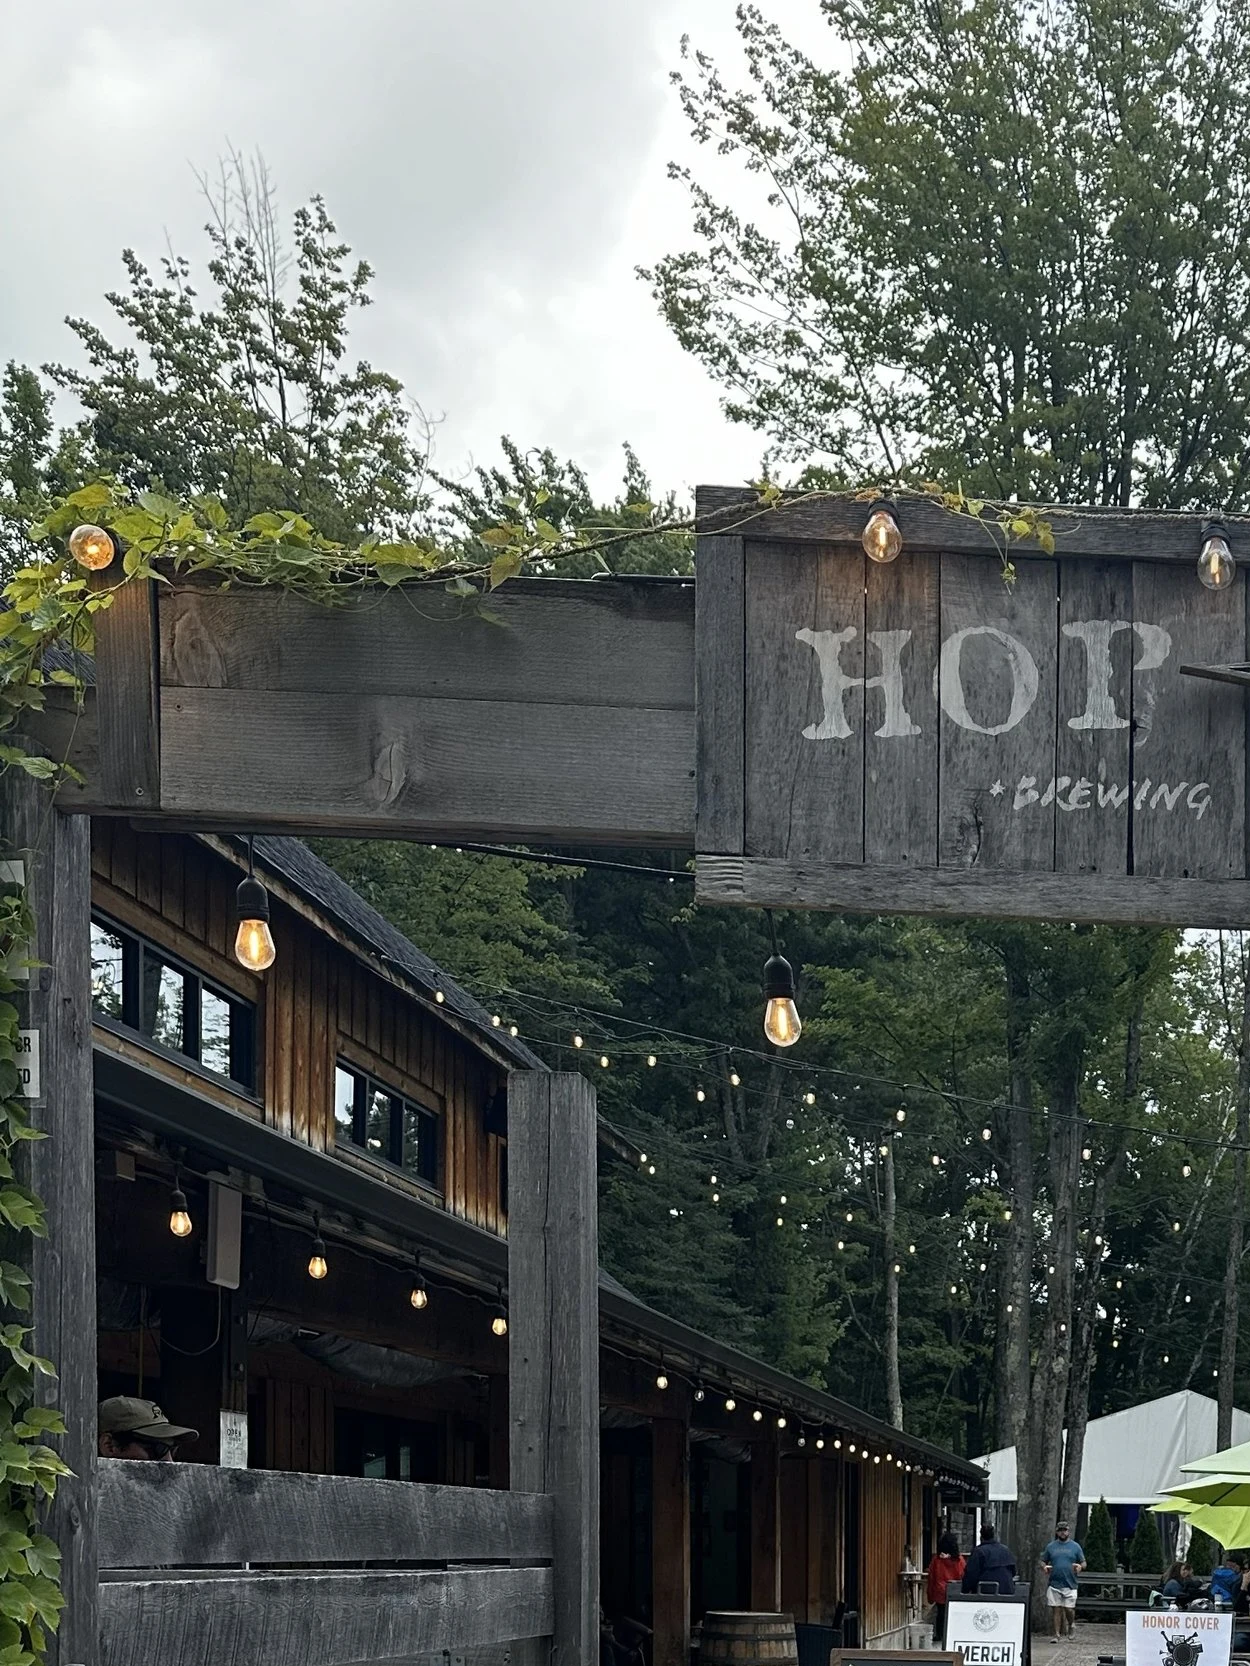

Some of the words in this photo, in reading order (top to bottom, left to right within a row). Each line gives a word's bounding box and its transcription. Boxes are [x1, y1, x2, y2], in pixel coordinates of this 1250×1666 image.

[795, 619, 1172, 740] HOP
[1013, 775, 1212, 820] BREWING
[1142, 1615, 1180, 1629] HONOR
[1185, 1616, 1219, 1631] COVER
[958, 1645, 1011, 1663] MERCH
